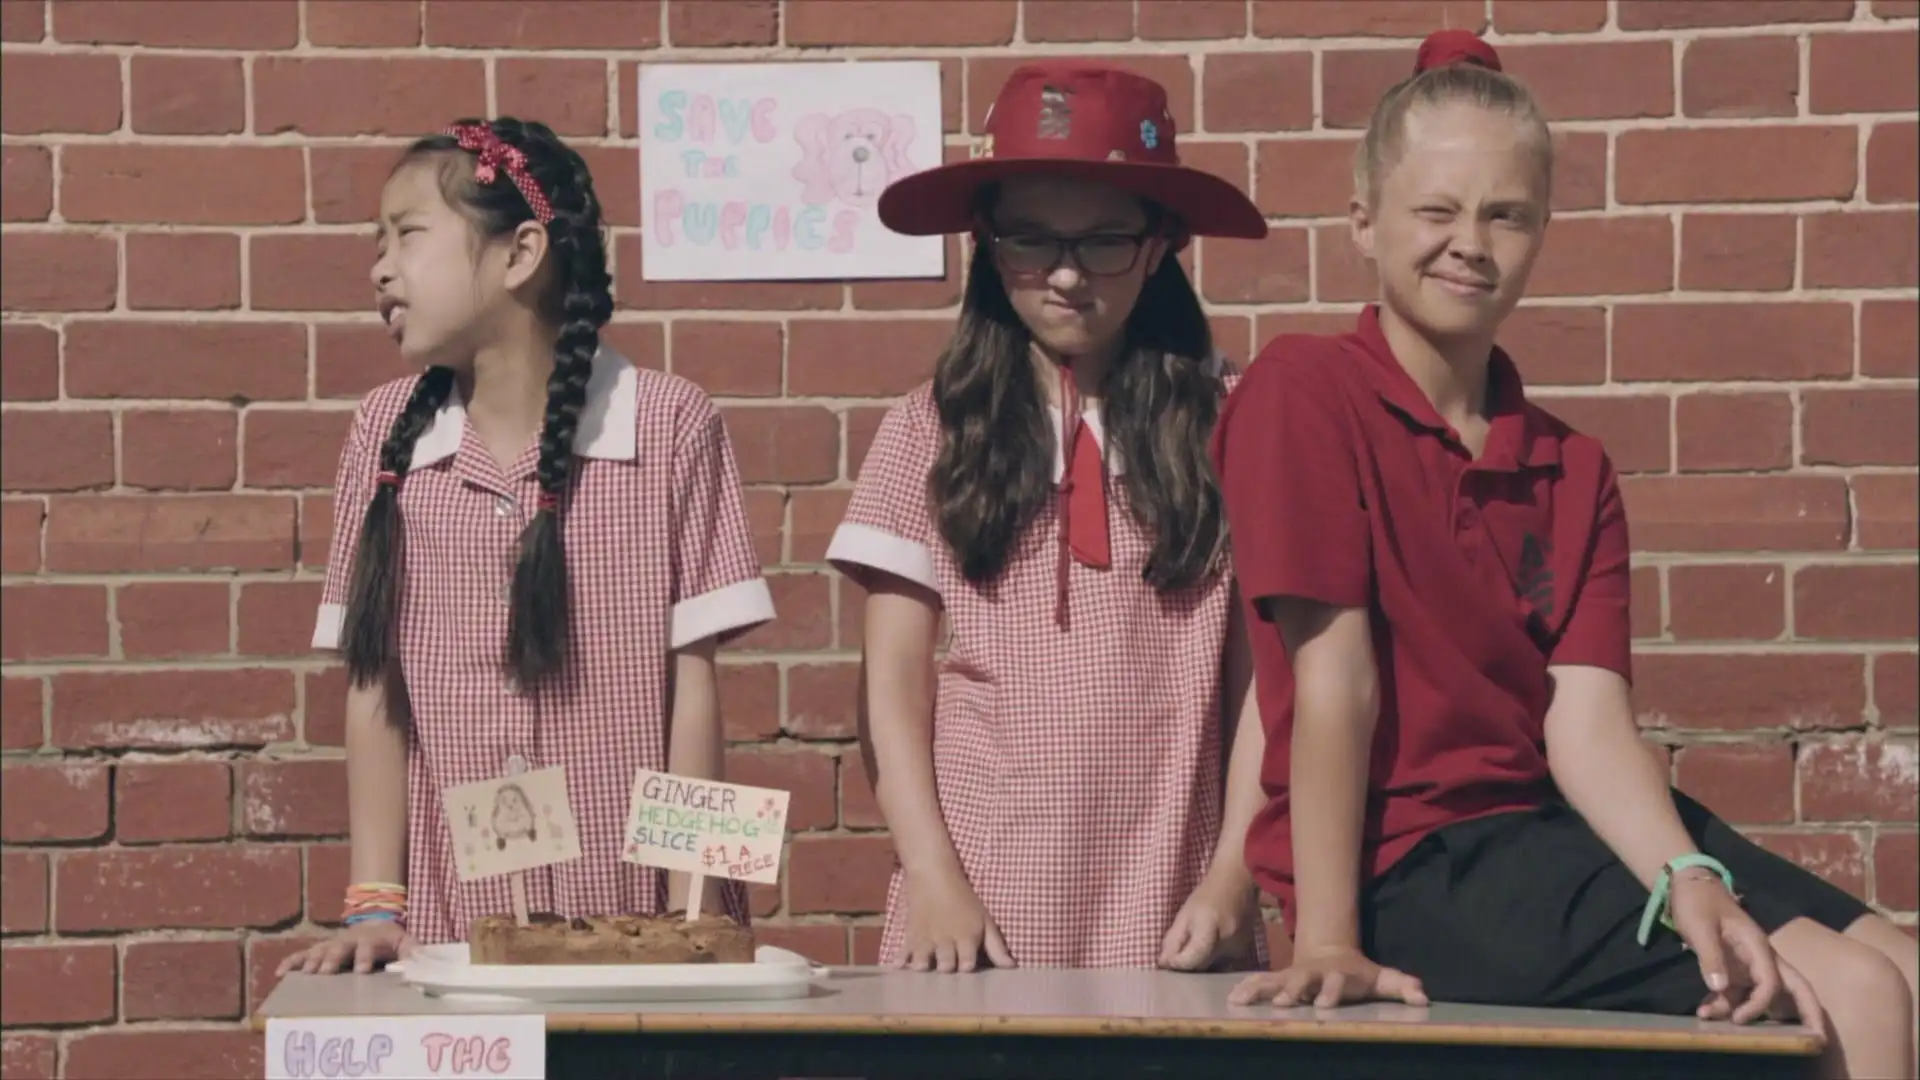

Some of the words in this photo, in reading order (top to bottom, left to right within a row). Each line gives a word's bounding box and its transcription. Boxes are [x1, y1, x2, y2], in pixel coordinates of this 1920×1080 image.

[654, 89, 777, 145] SAVE
[653, 188, 858, 254] PUPPIES
[642, 776, 737, 813] GINGER
[638, 804, 760, 838] HEDGEHOG
[632, 826, 698, 852] SLICE
[702, 844, 731, 869] $1
[739, 845, 750, 861] A
[727, 853, 775, 878] PIECE
[284, 1030, 393, 1078] HELP
[421, 1032, 511, 1073] THE
